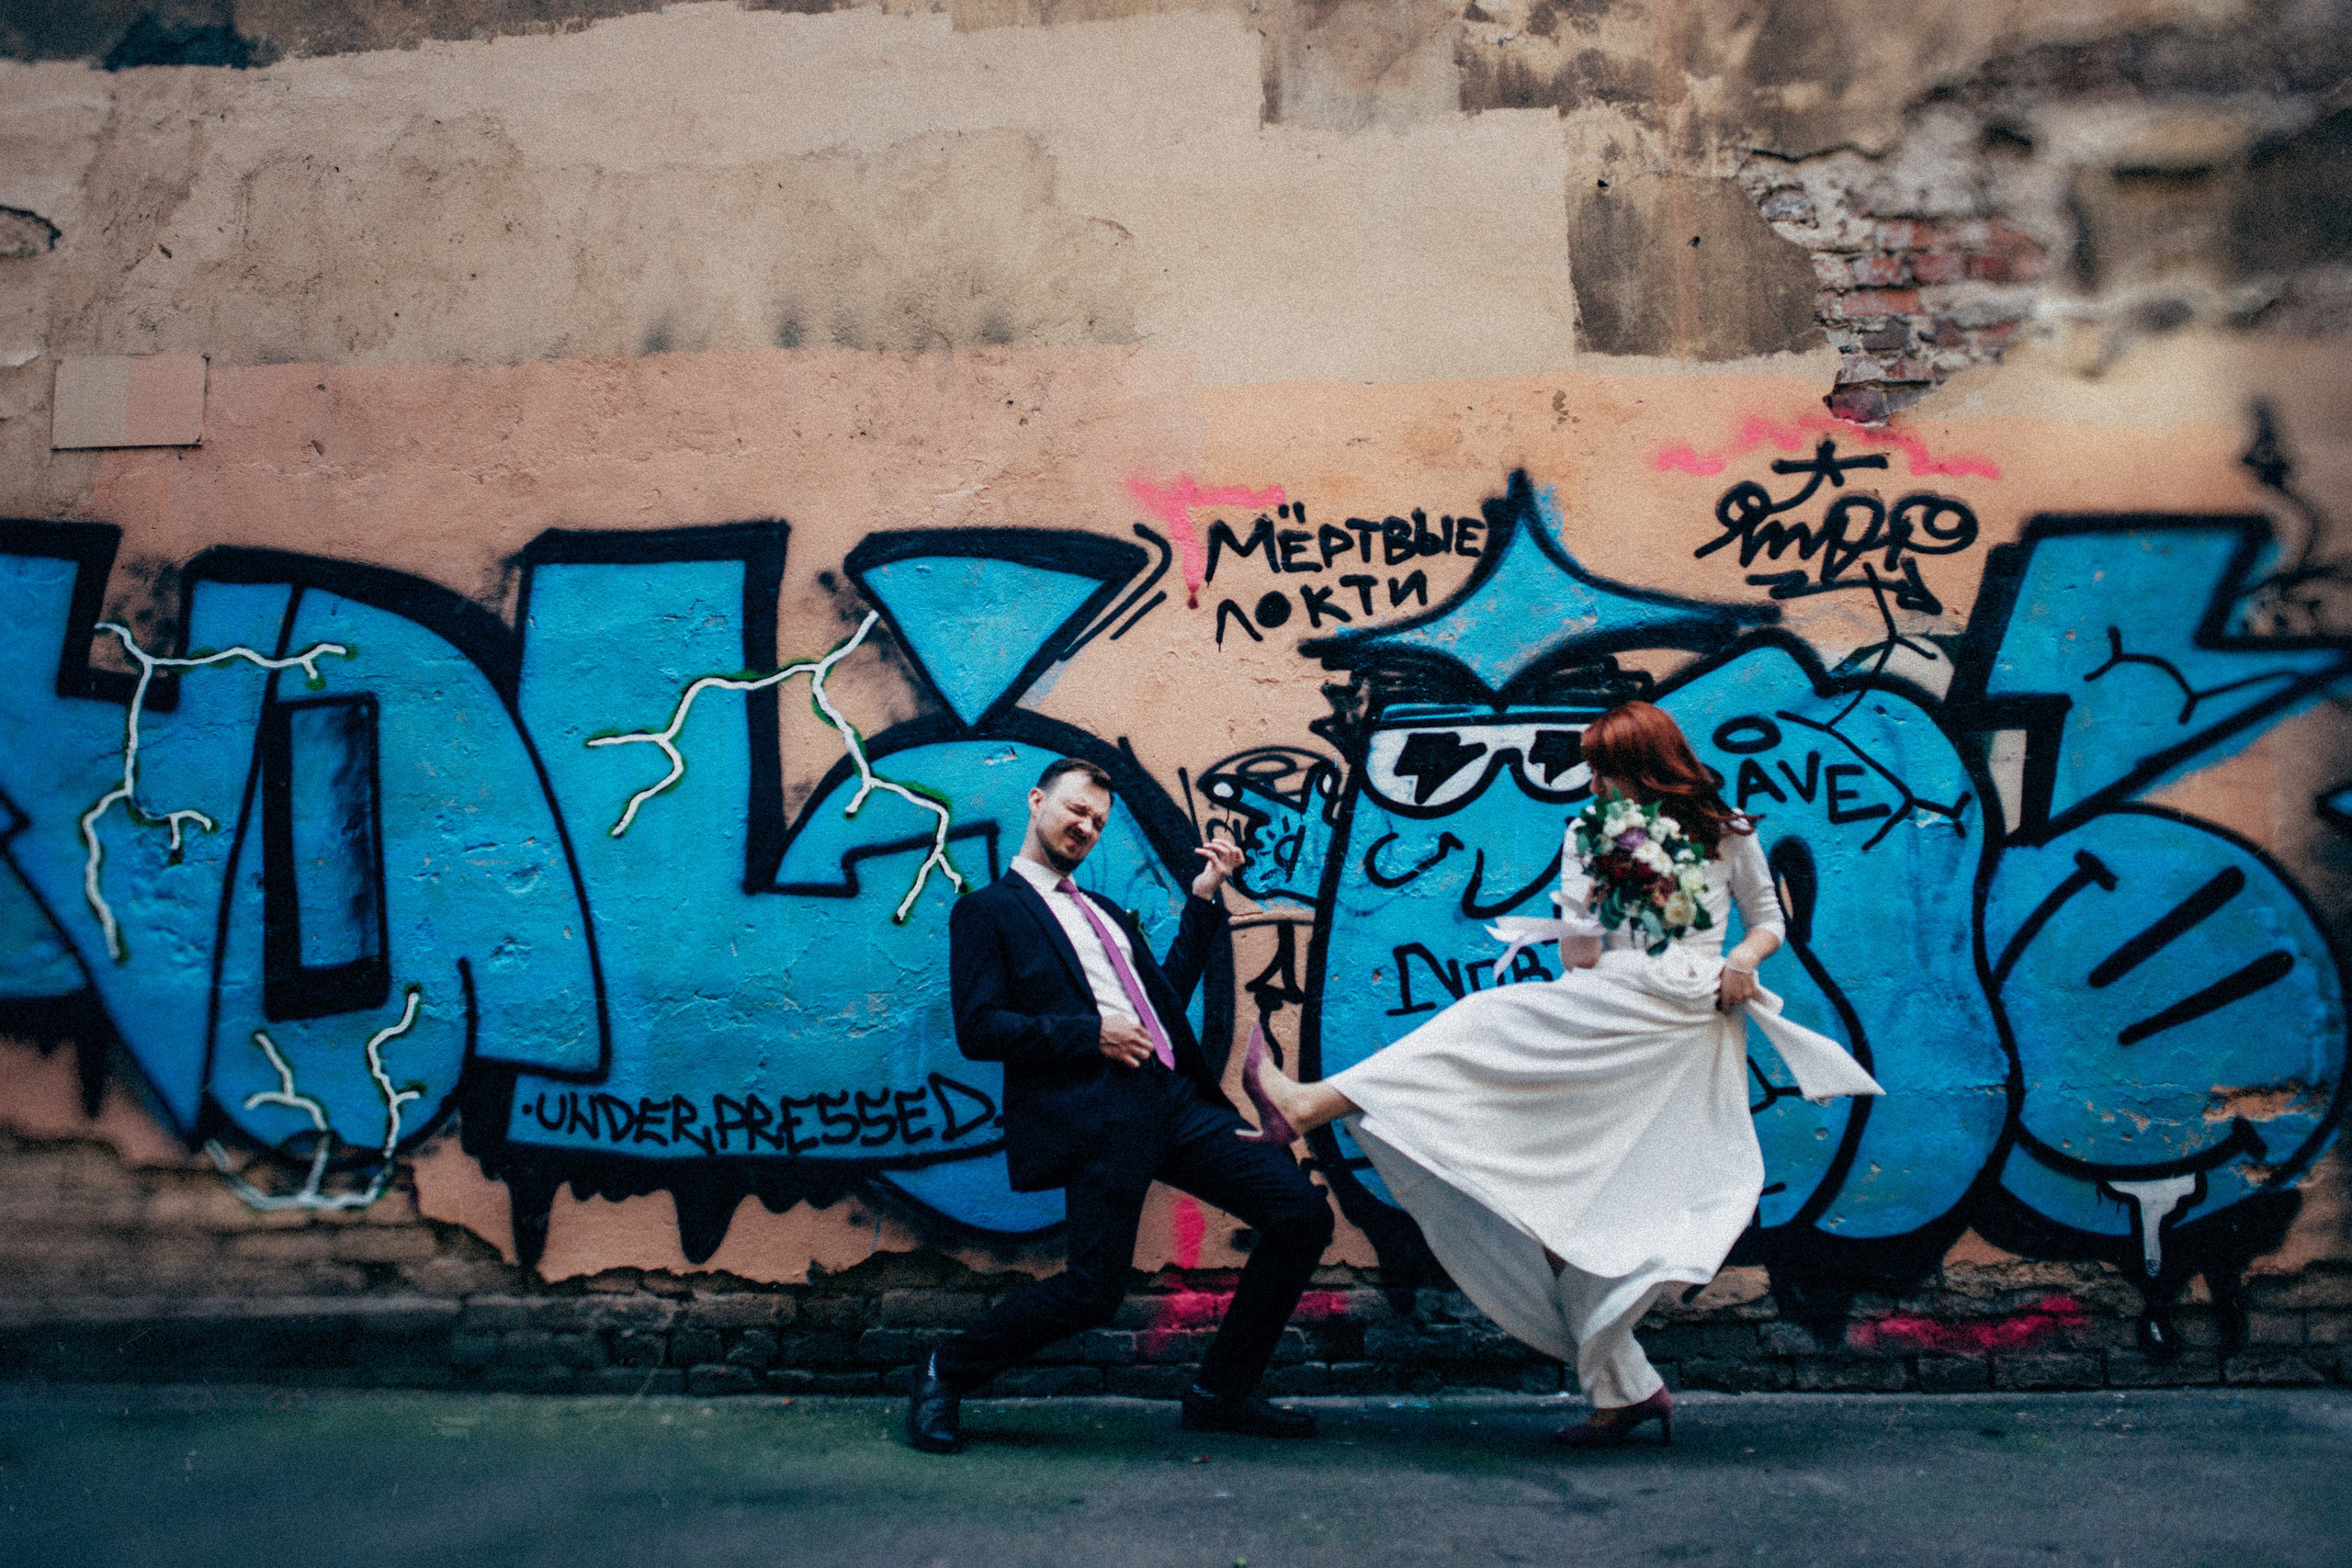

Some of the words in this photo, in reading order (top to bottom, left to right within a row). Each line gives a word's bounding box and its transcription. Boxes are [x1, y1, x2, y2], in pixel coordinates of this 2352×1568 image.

[1205, 502, 1486, 586] МЁРТВЫЕ
[1216, 569, 1429, 647] ЛОКТИ
[1700, 750, 1892, 825] AVE
